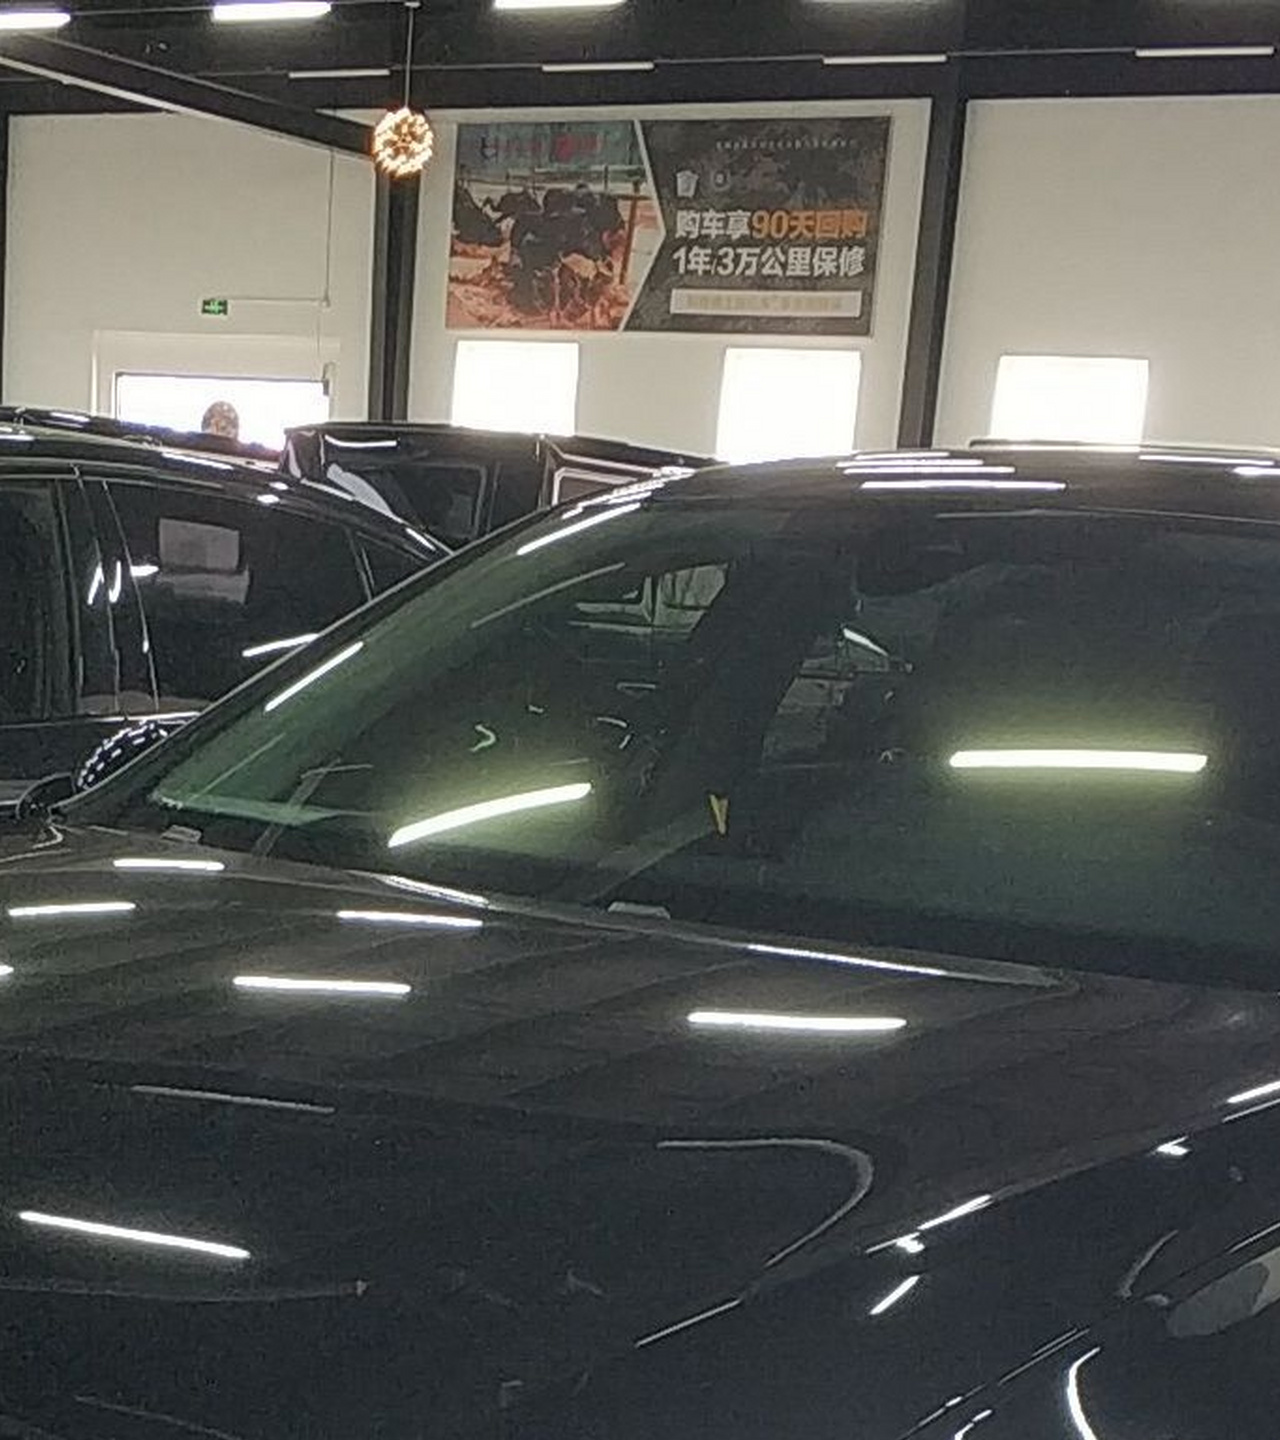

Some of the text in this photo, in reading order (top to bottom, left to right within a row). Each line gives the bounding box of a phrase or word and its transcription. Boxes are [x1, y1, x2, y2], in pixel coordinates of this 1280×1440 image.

[675, 209, 868, 240] 购车享90天回购
